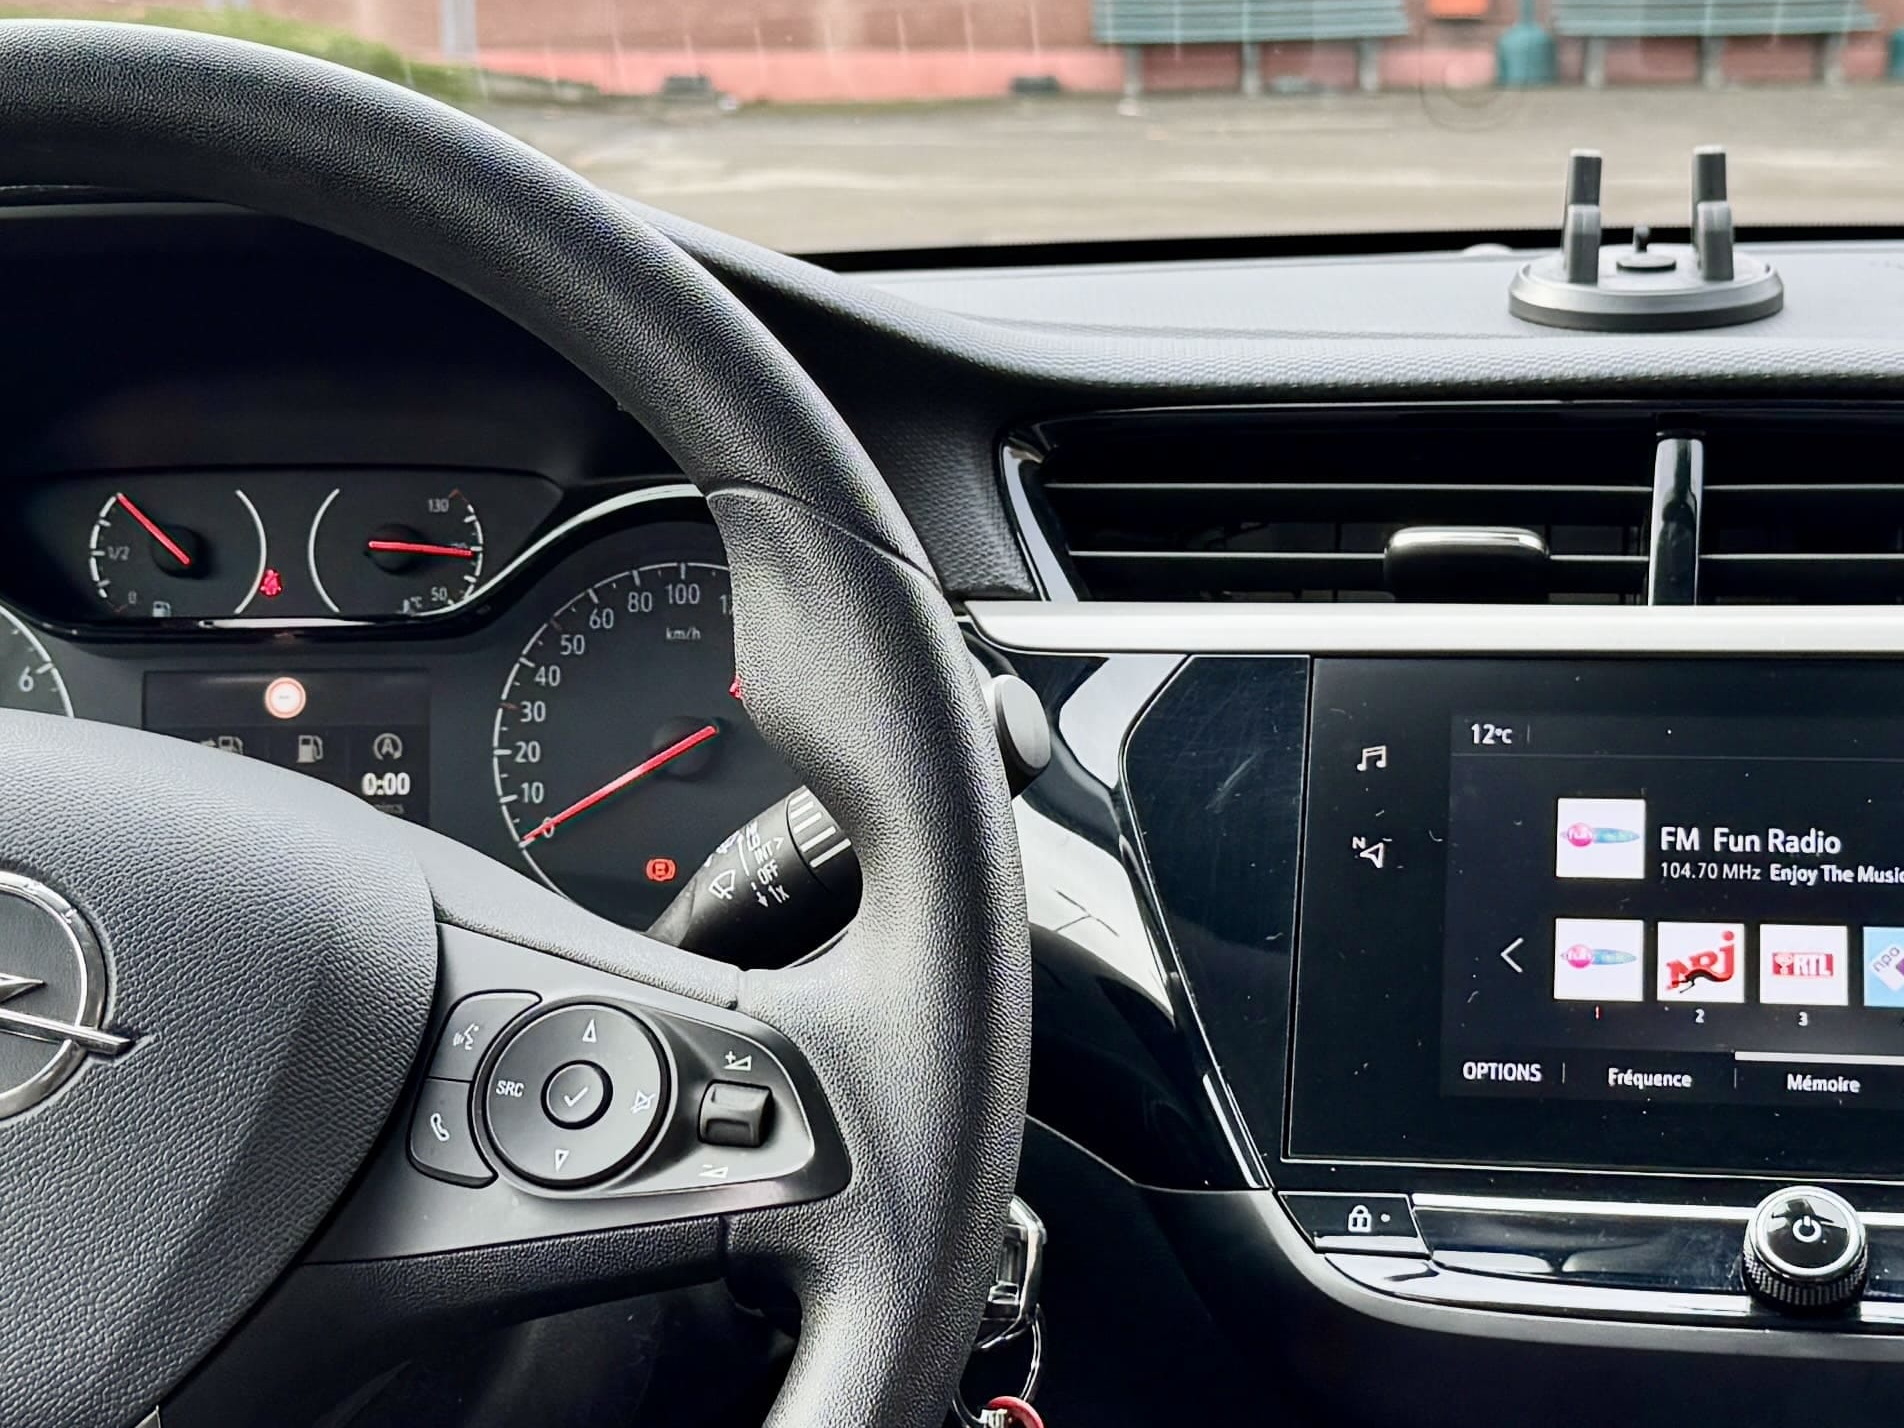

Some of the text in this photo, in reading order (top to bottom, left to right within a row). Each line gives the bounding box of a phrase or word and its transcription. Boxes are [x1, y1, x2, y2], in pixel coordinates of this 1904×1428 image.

[428, 498, 449, 512] 130
[108, 546, 130, 561] 1/2
[431, 586, 448, 601] 50
[627, 591, 653, 613] 80
[666, 583, 700, 605] 100
[589, 607, 614, 630] 60
[560, 634, 585, 656] 50
[665, 627, 701, 641] km/h
[18, 666, 35, 693] 6
[534, 665, 561, 687] 40
[520, 701, 546, 722] 30
[514, 740, 541, 763] 20
[361, 772, 411, 796] 0:00
[520, 782, 545, 804] 10
[754, 839, 776, 865] INT
[1660, 827, 1700, 852] FM
[1713, 828, 1761, 853] Fun
[1767, 828, 1842, 855] Radio
[756, 859, 779, 886] OFF
[1660, 861, 1718, 881] 104.70
[1722, 863, 1761, 882] MHz
[1769, 863, 1818, 887] Enjoy
[1820, 864, 1854, 884] The
[1794, 953, 1834, 977] RTL
[1872, 946, 1901, 973] npo
[1695, 1009, 1705, 1024] 2
[1798, 1011, 1809, 1026] 3
[1462, 1060, 1543, 1083] OPTIONS
[1608, 1067, 1694, 1090] Fréquence
[1787, 1073, 1862, 1094] Mémoire
[495, 1080, 524, 1099] SRC
